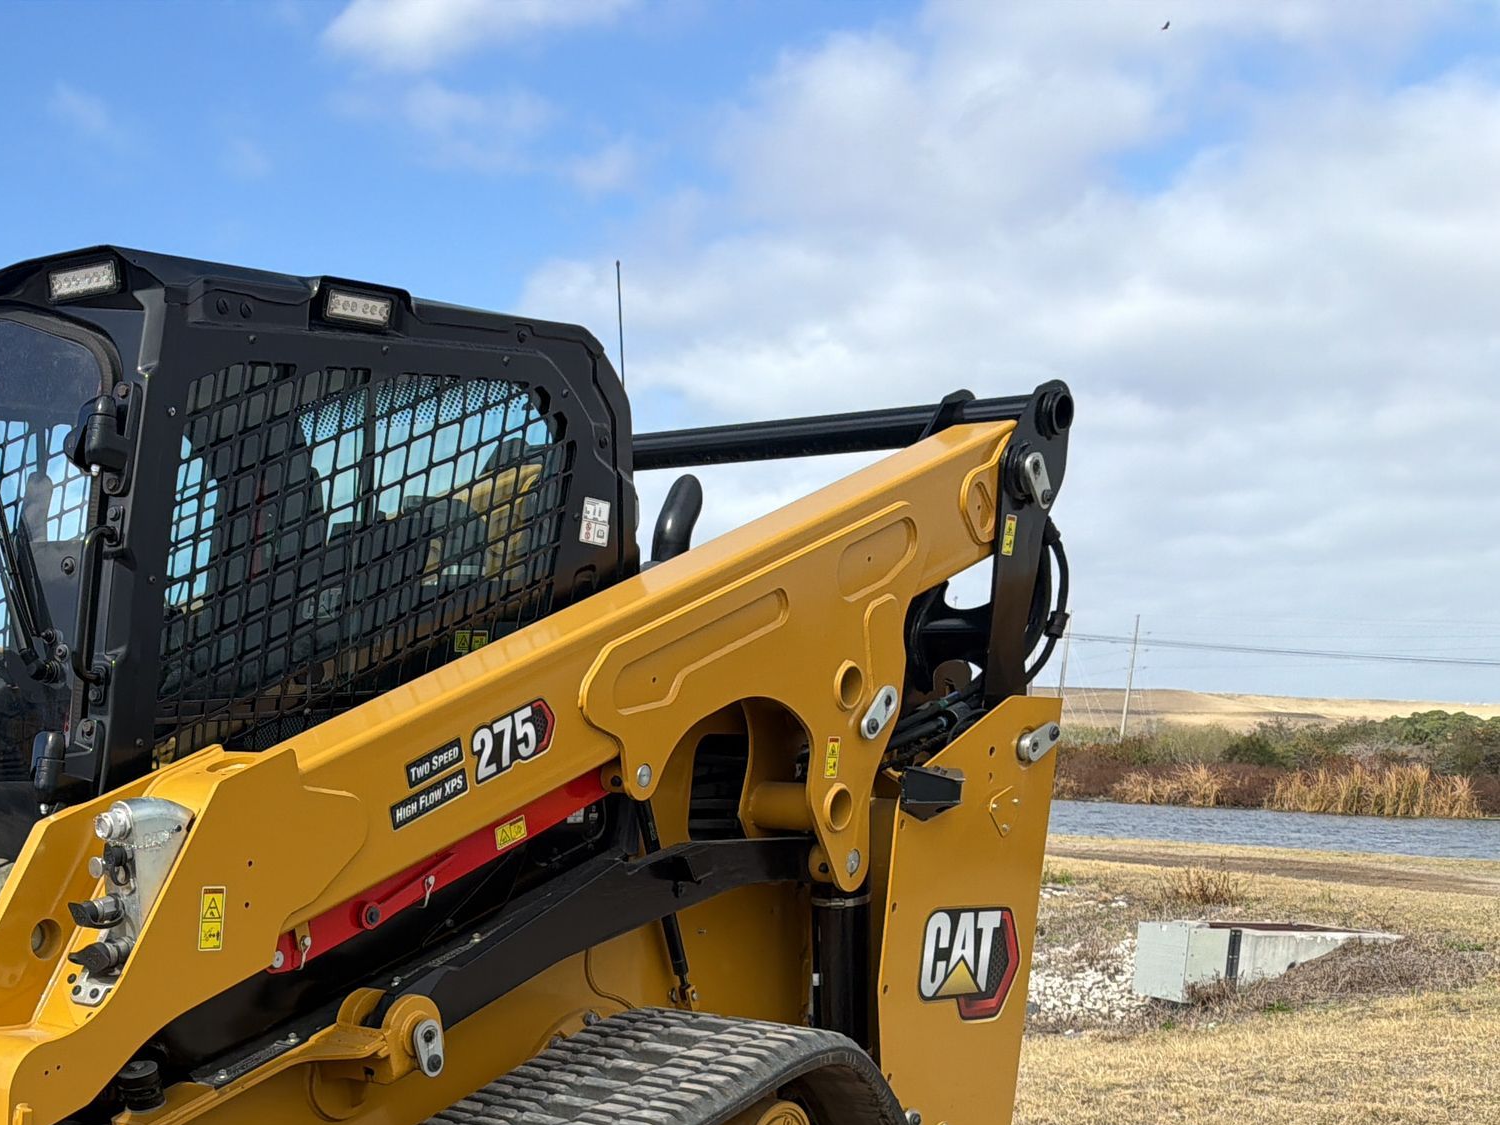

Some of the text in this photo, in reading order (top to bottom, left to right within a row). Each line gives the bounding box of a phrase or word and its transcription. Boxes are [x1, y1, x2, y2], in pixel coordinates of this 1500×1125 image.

[472, 705, 537, 781] 275
[444, 774, 463, 797] XPS
[920, 910, 1003, 998] CAT
